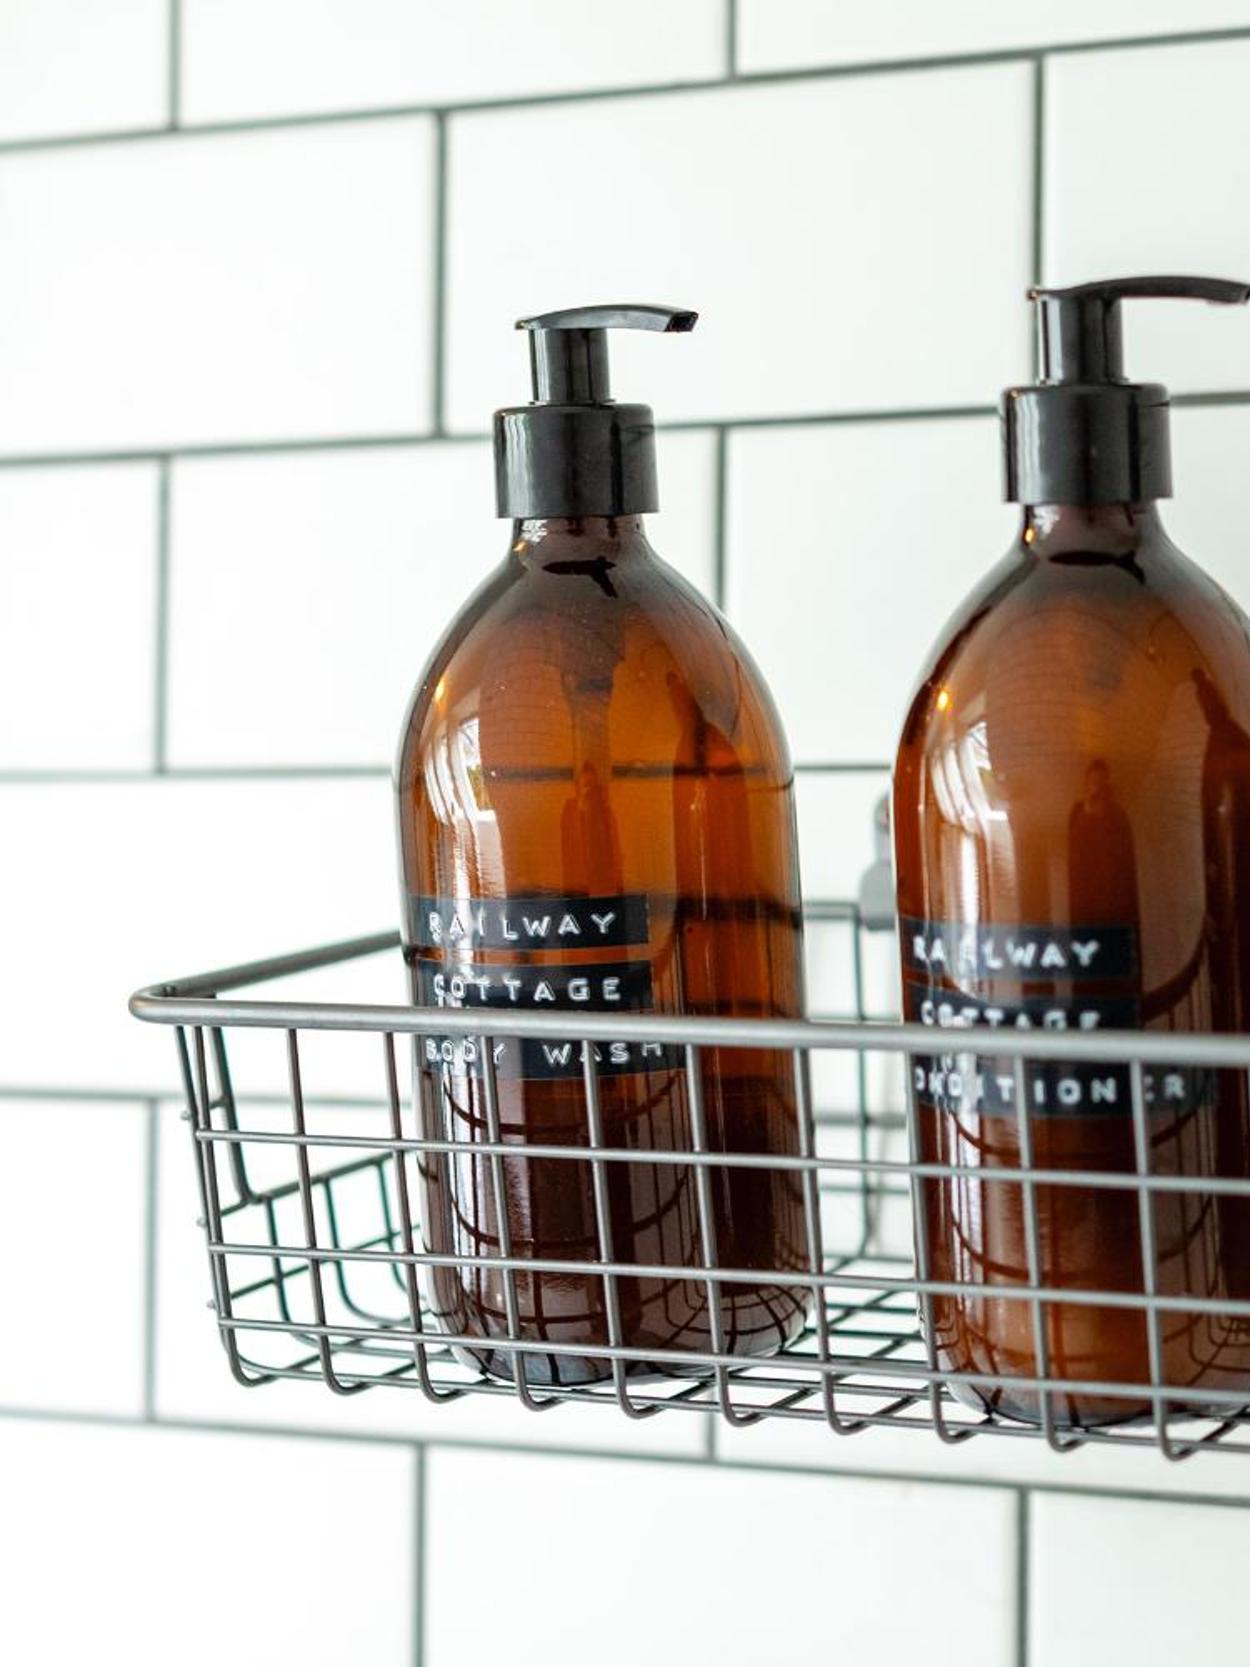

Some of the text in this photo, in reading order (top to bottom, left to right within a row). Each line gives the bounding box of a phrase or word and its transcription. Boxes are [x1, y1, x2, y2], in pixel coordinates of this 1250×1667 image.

[429, 910, 615, 942] RAILWAY
[433, 973, 622, 1002] COTTAGE
[426, 1036, 504, 1064] BODY
[914, 1064, 1186, 1104] ONDITIONR
